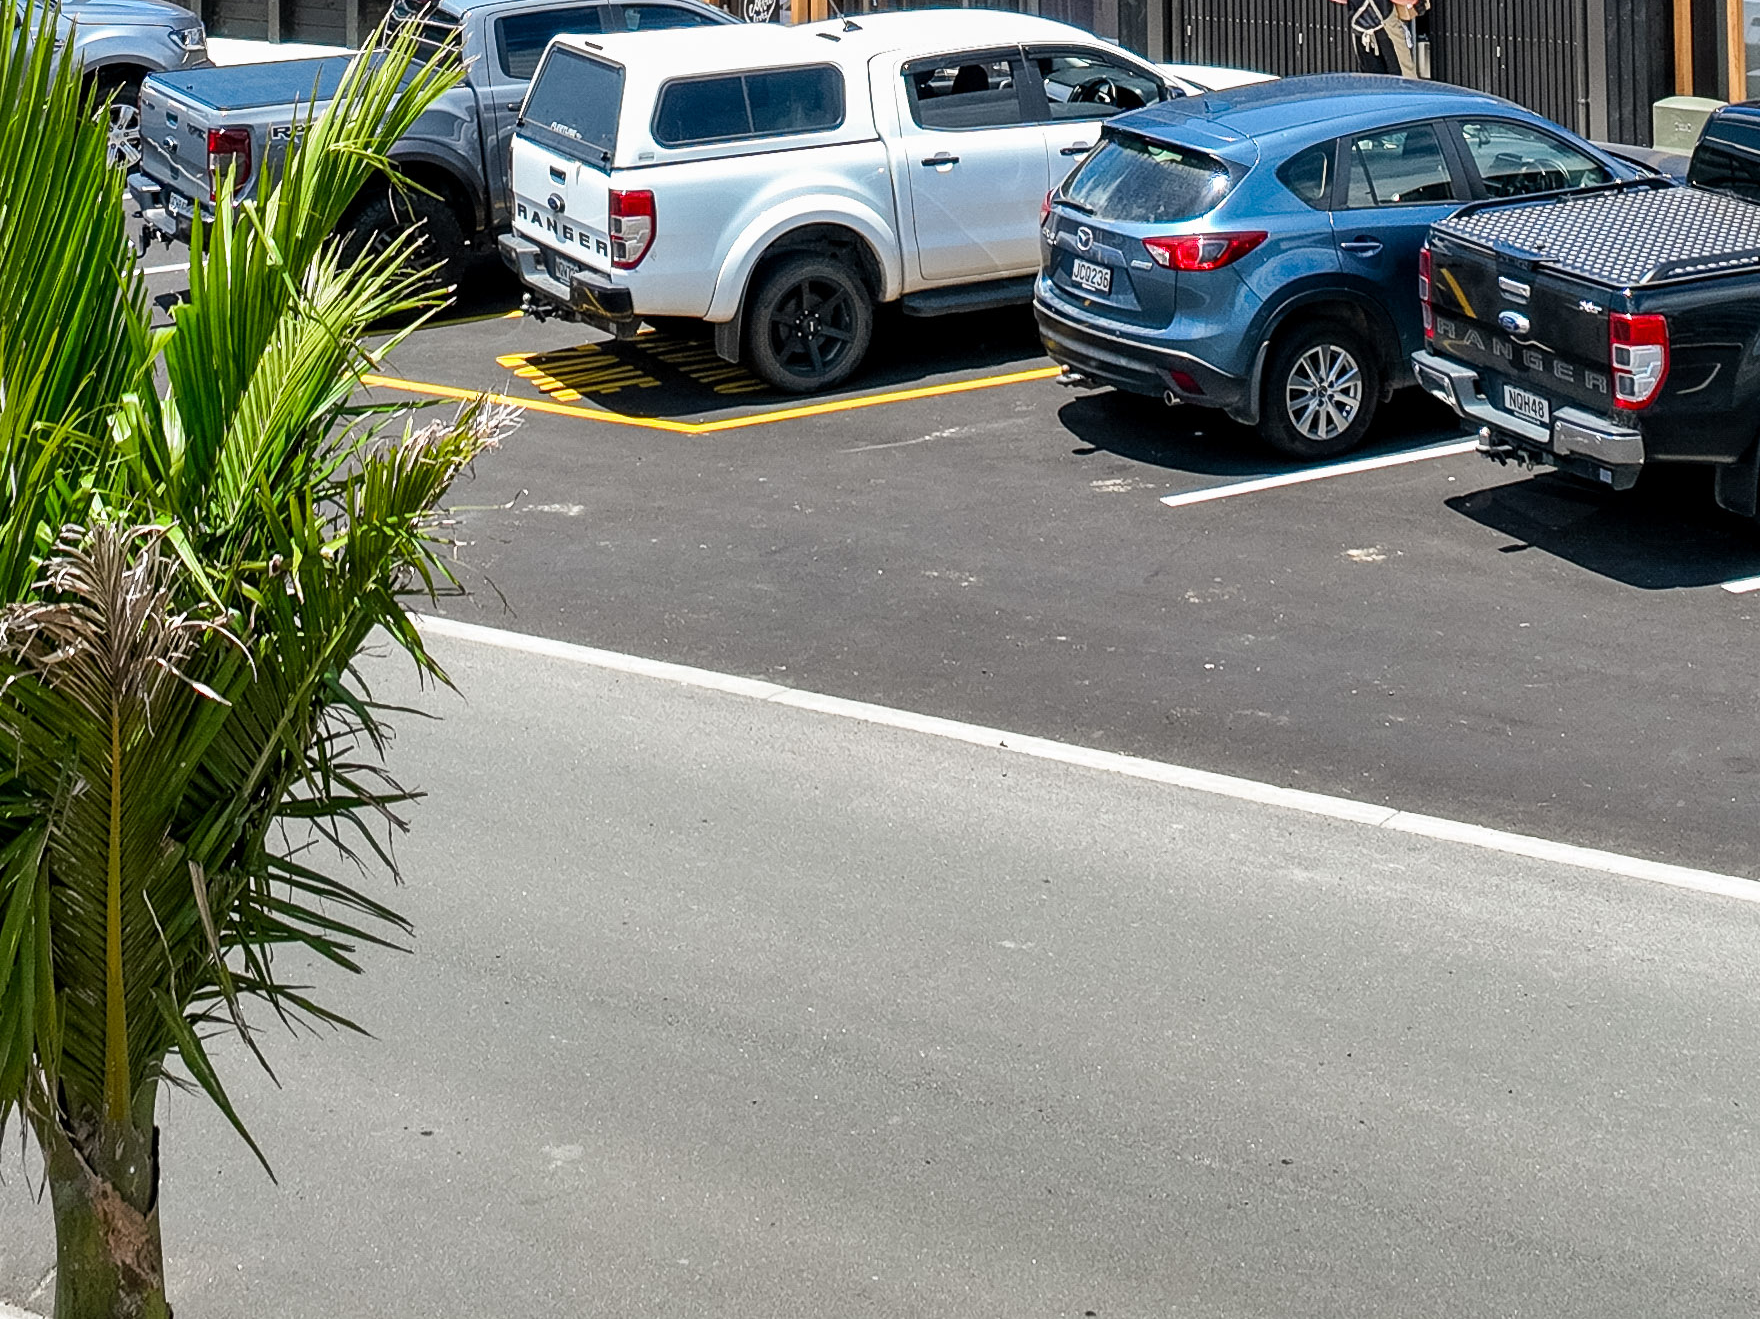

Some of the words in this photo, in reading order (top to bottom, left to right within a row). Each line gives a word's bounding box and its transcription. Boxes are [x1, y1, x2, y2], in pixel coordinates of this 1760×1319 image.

[517, 203, 608, 257] RANGER
[1073, 263, 1109, 289] JCQ236
[1437, 316, 1607, 394] RANGER
